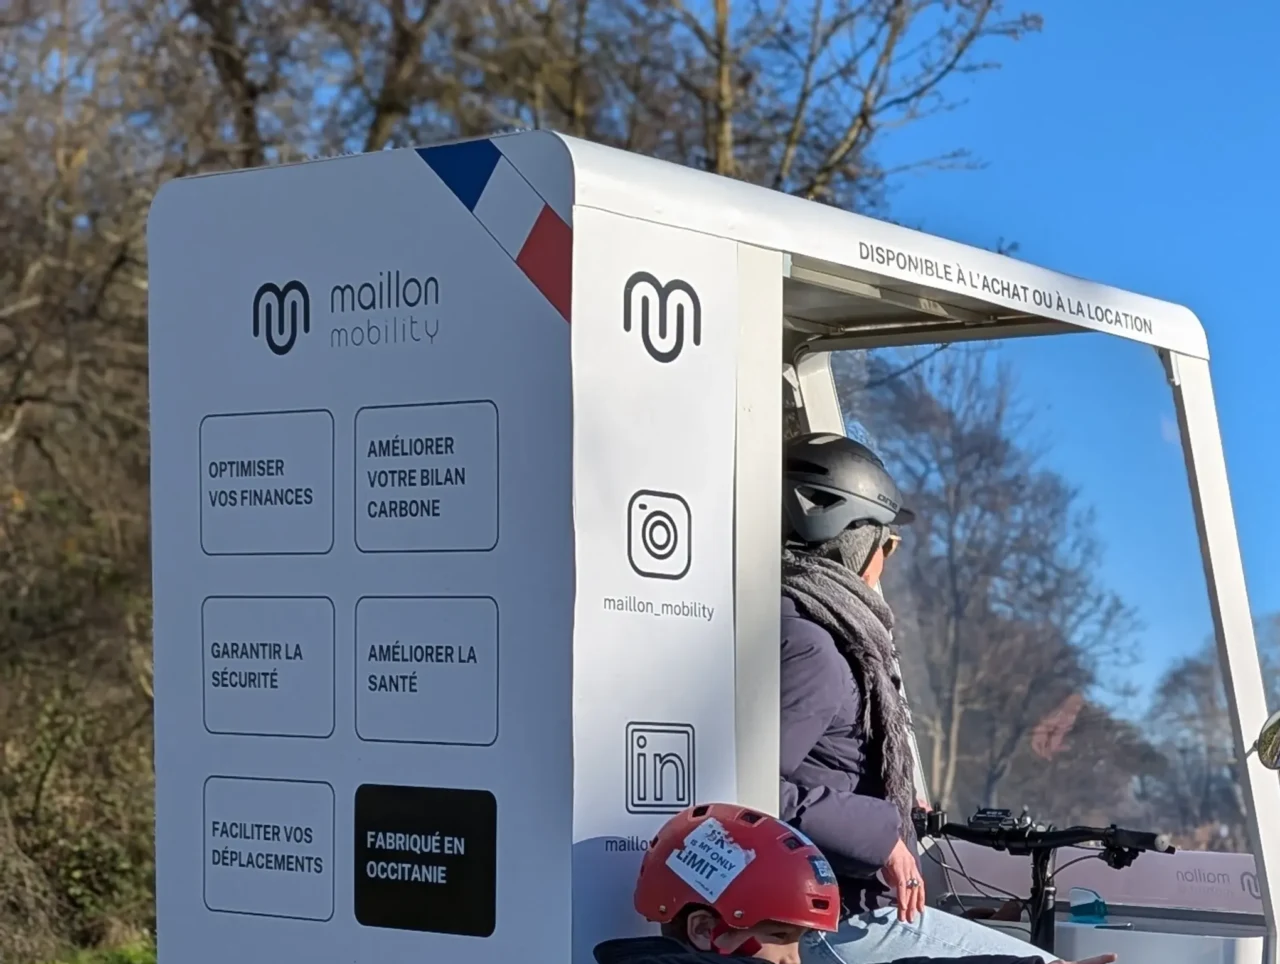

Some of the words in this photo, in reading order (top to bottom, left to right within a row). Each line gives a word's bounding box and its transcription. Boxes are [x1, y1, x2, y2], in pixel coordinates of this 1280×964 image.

[330, 270, 439, 314] maillon
[858, 241, 953, 282] DISPONIBLE
[956, 262, 967, 286] À
[969, 271, 1029, 303] L'ACHAT
[1033, 289, 1052, 309] OU
[1055, 291, 1066, 313] À
[1067, 298, 1085, 318] LA
[1087, 303, 1153, 335] LOCATION
[330, 315, 440, 348] mobility
[367, 435, 455, 458] AMÉLIORER
[208, 459, 285, 479] OPTIMISER
[367, 469, 417, 488] VOTRE
[420, 467, 466, 487] BILAN
[208, 489, 238, 507] VOS
[240, 487, 313, 507] FINANCES
[367, 499, 441, 519] CARBONE
[603, 596, 715, 622] maillon_mobility
[211, 642, 282, 660] GARANTIR
[285, 643, 303, 661] LA
[368, 640, 454, 663] AMÉLIORER
[458, 645, 478, 664] LA
[211, 668, 279, 689] SÉCURITÉ
[368, 671, 418, 693] SANTÉ
[212, 820, 281, 842] FACILITER
[283, 825, 313, 844] VOS
[367, 831, 441, 855] FABRIQUÉ
[444, 836, 465, 855] EN
[212, 847, 323, 874] DÉPLACEMENTS
[698, 842, 713, 853] MY
[710, 851, 736, 871] ONLY
[366, 861, 447, 884] OCCITANIE
